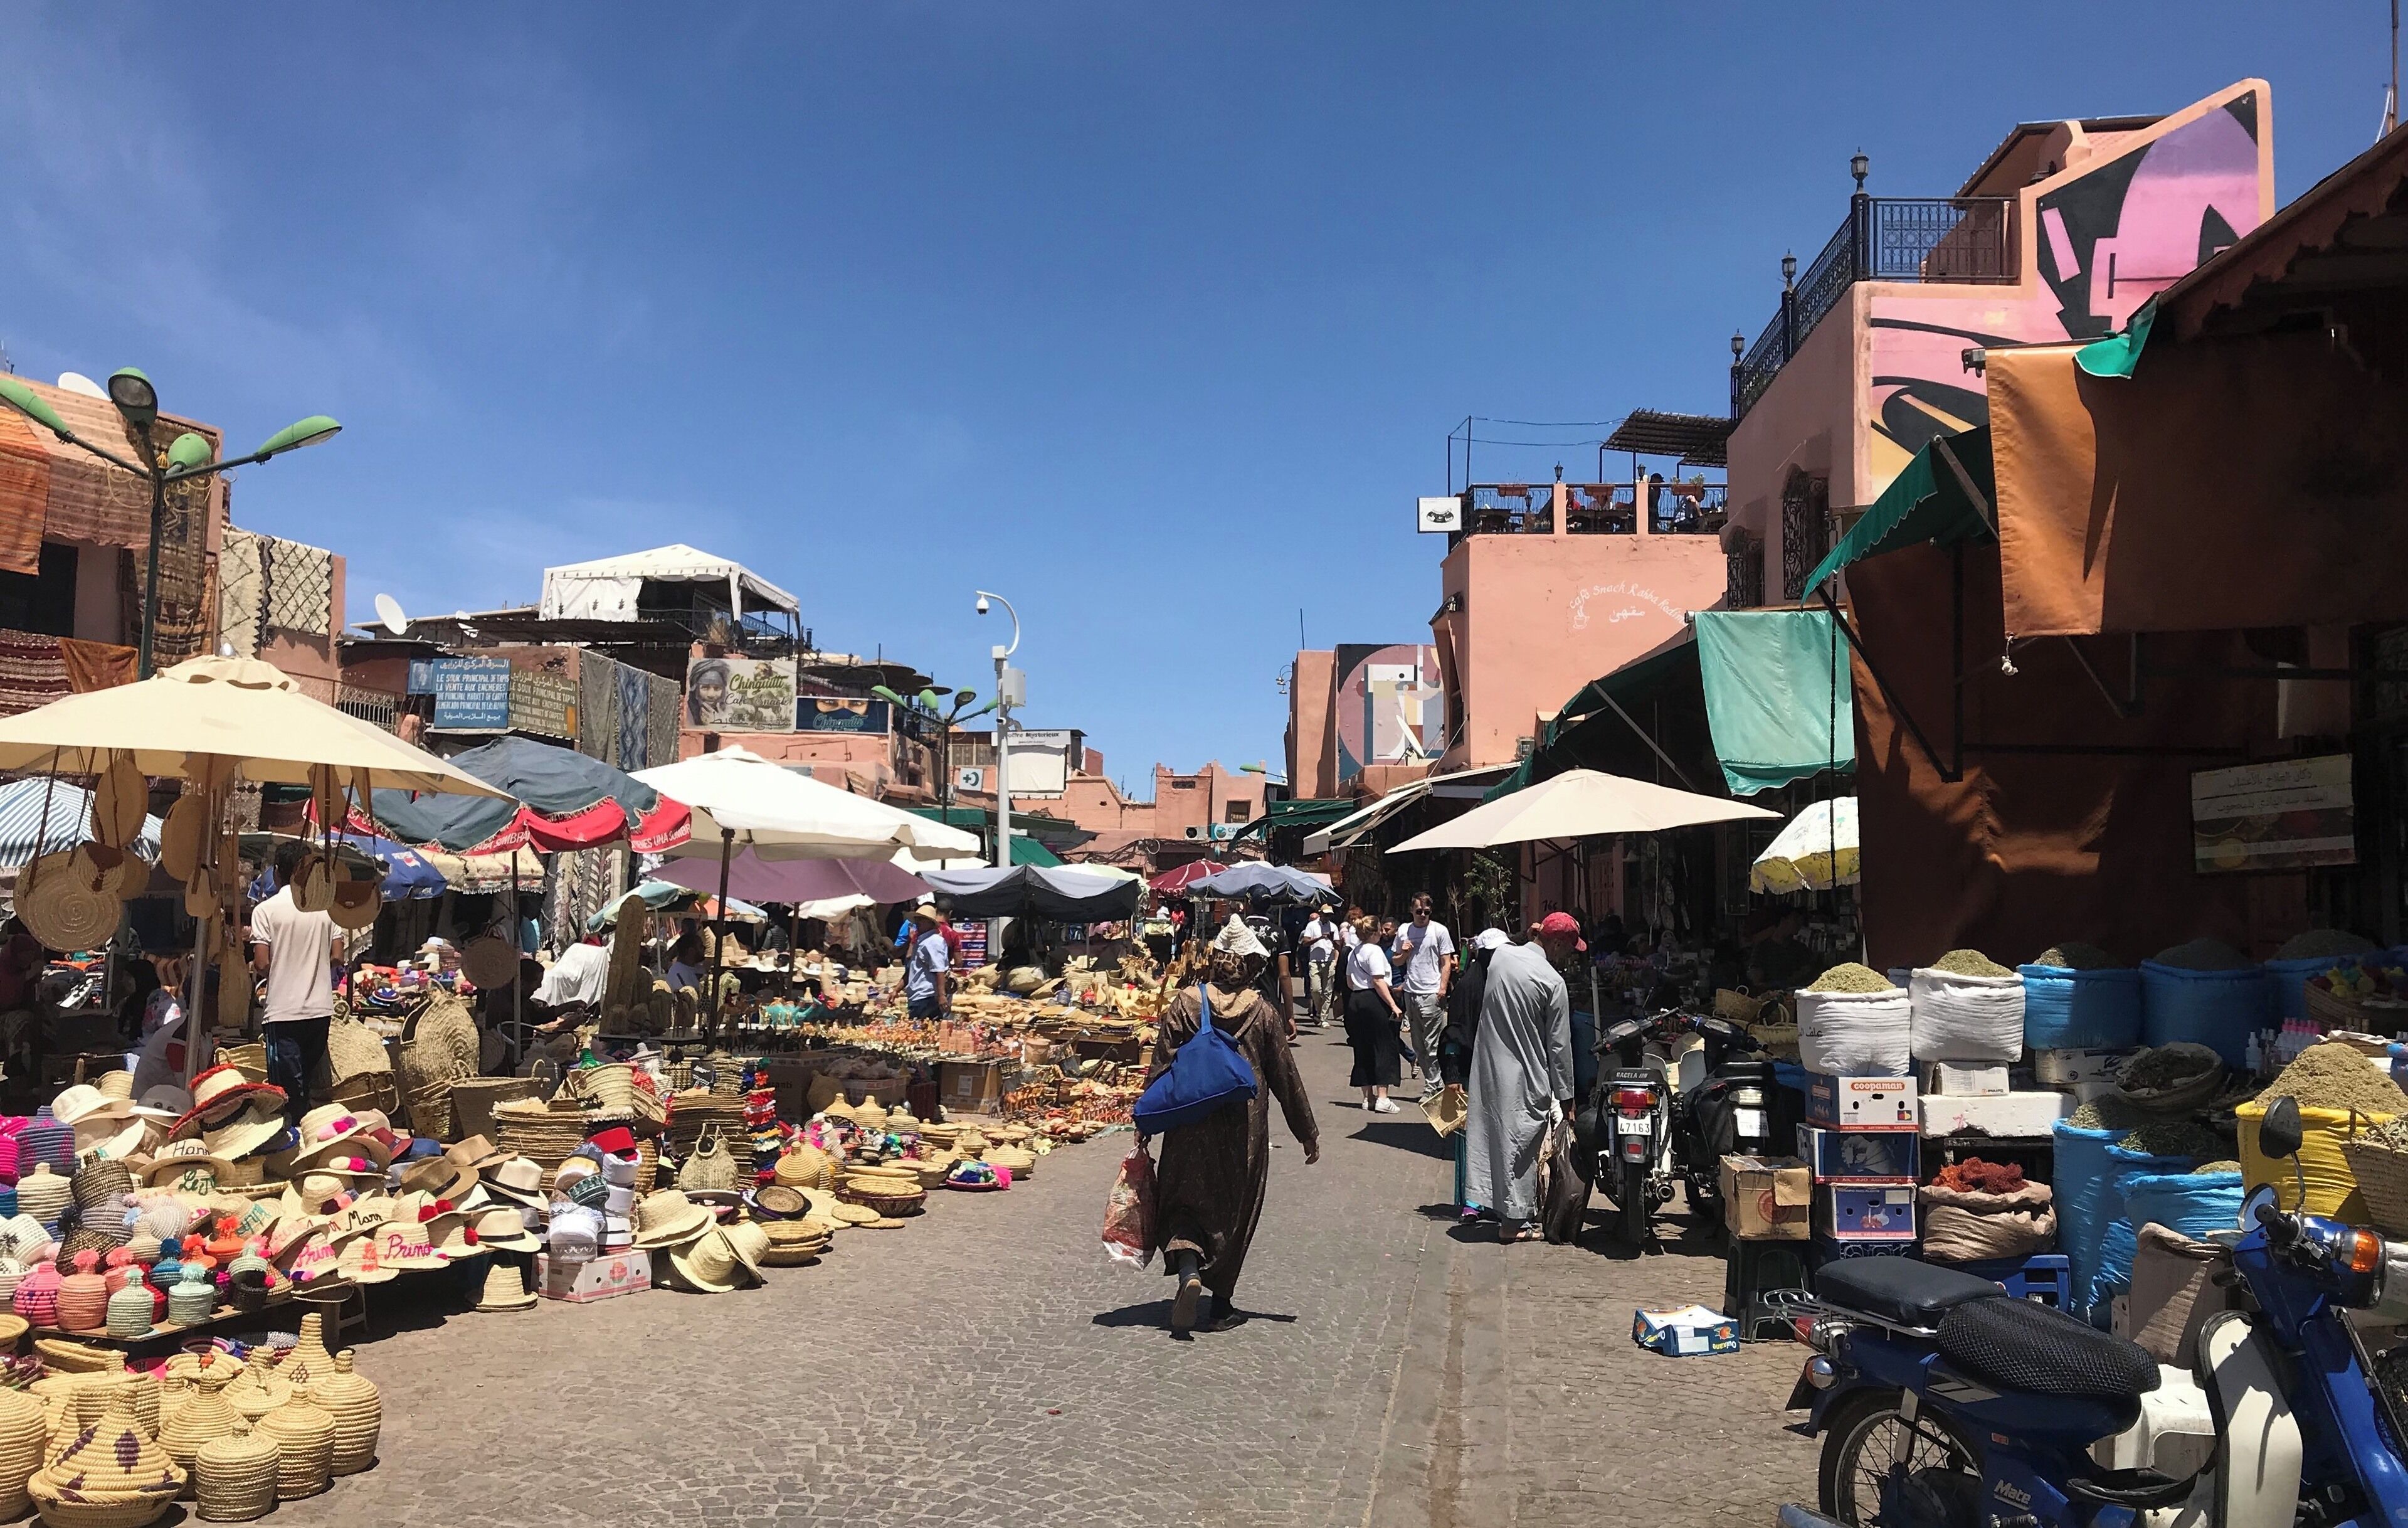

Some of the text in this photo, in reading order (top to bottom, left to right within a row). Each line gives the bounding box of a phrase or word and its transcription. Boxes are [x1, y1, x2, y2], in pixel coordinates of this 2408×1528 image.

[436, 674, 445, 682] LE
[446, 674, 461, 682] SOUK
[436, 682, 443, 692] LA
[445, 682, 463, 692] VENTE
[464, 682, 476, 692] AUX
[1853, 1083, 1903, 1091] coopaman
[1634, 1110, 1646, 1120] 26
[1619, 1123, 1650, 1133] 47163
[1993, 1479, 2032, 1505] Mate
